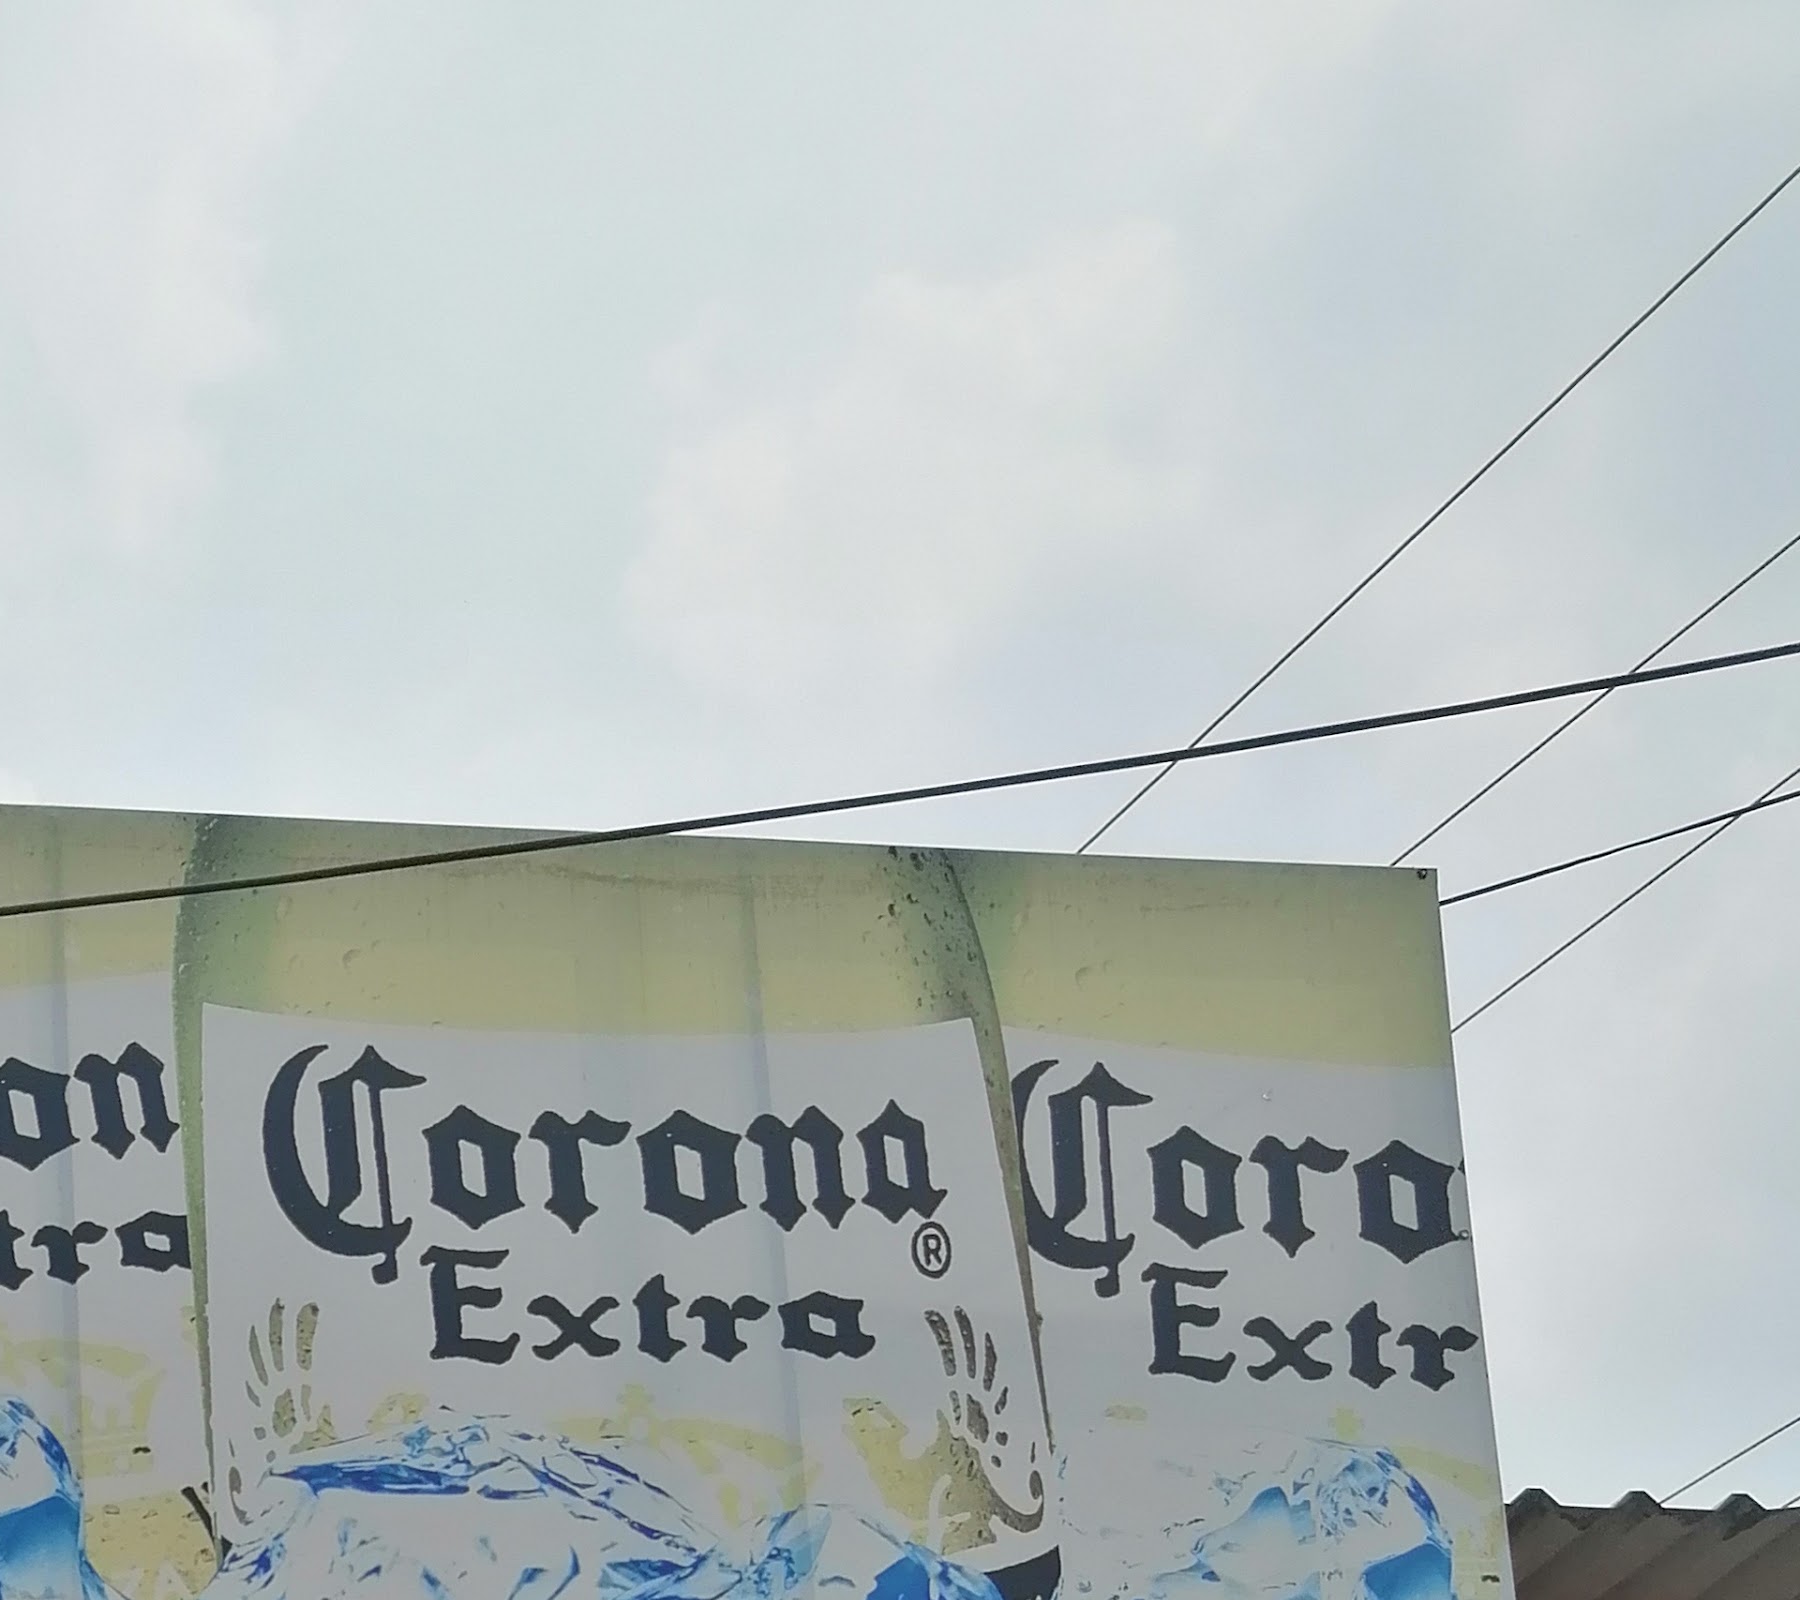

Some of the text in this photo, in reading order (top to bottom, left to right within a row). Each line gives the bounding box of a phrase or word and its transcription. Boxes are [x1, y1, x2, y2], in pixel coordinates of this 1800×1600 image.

[263, 1044, 948, 1285] Corona
[1010, 1060, 1464, 1297] Coro
[420, 1246, 876, 1364] Extra
[1141, 1262, 1478, 1391] Extr
